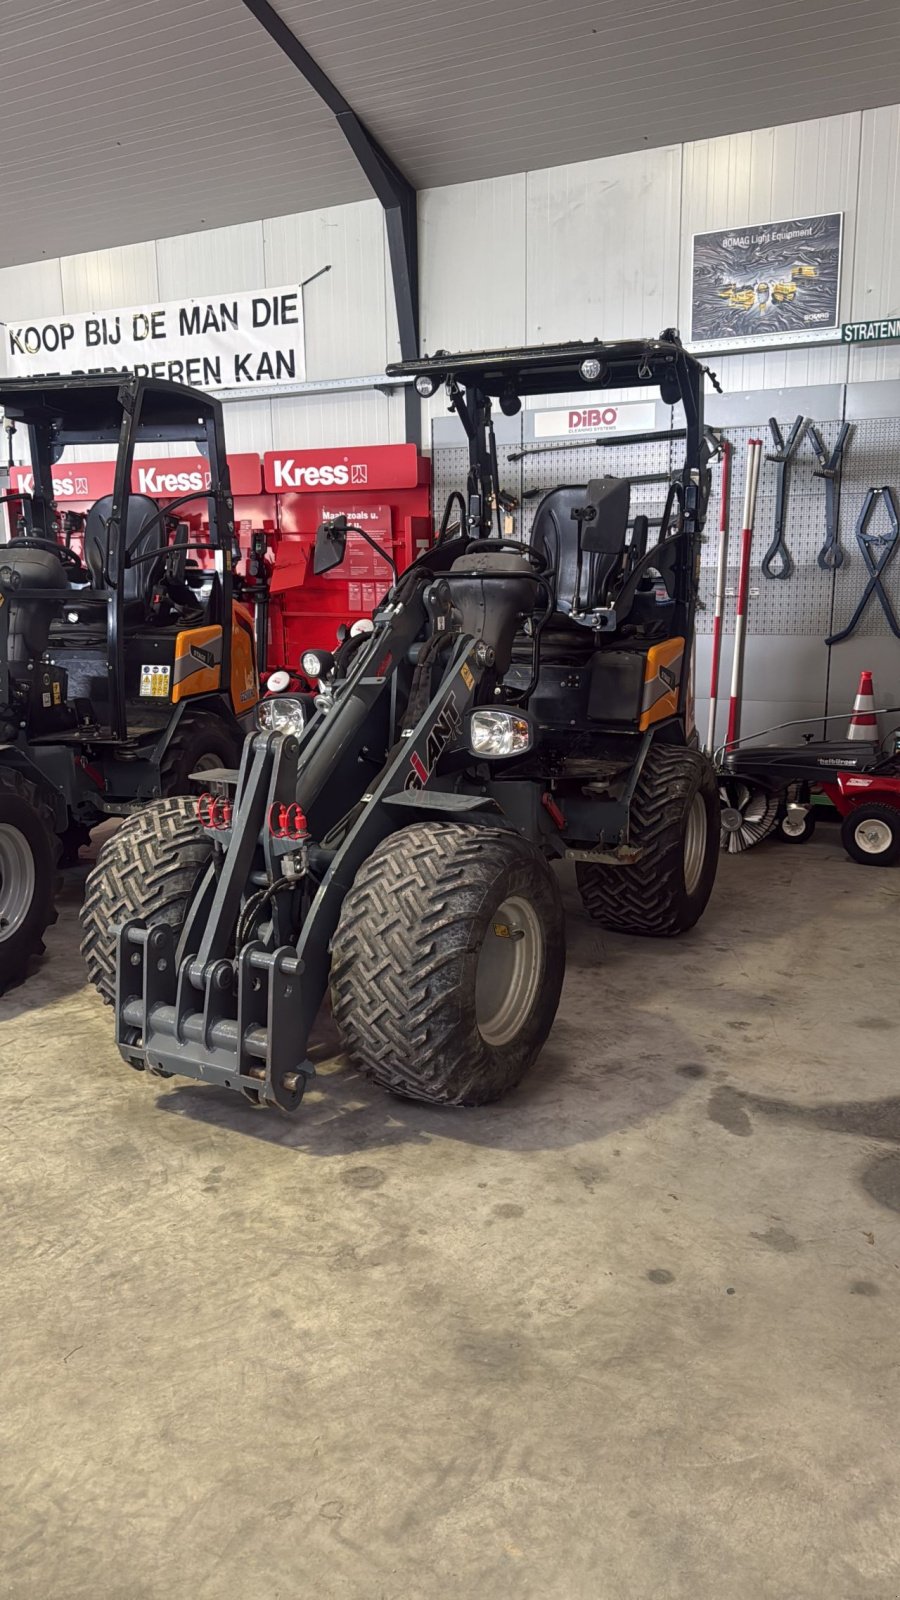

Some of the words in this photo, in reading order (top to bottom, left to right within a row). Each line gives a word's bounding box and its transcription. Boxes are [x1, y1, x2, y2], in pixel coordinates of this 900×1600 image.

[722, 235, 751, 248] BOMAG
[751, 232, 770, 244] Light
[771, 227, 813, 241] Equipment
[10, 322, 75, 356] KOOP
[85, 316, 121, 347] BIJ
[133, 310, 166, 341] DE
[179, 301, 238, 336] MAN
[252, 293, 299, 328] DIE
[234, 349, 296, 383] KAN
[16, 473, 74, 496] Kss
[138, 466, 203, 493] Kress
[274, 458, 348, 488] Kress
[347, 511, 368, 520] zoals
[404, 689, 460, 791] GIANT
